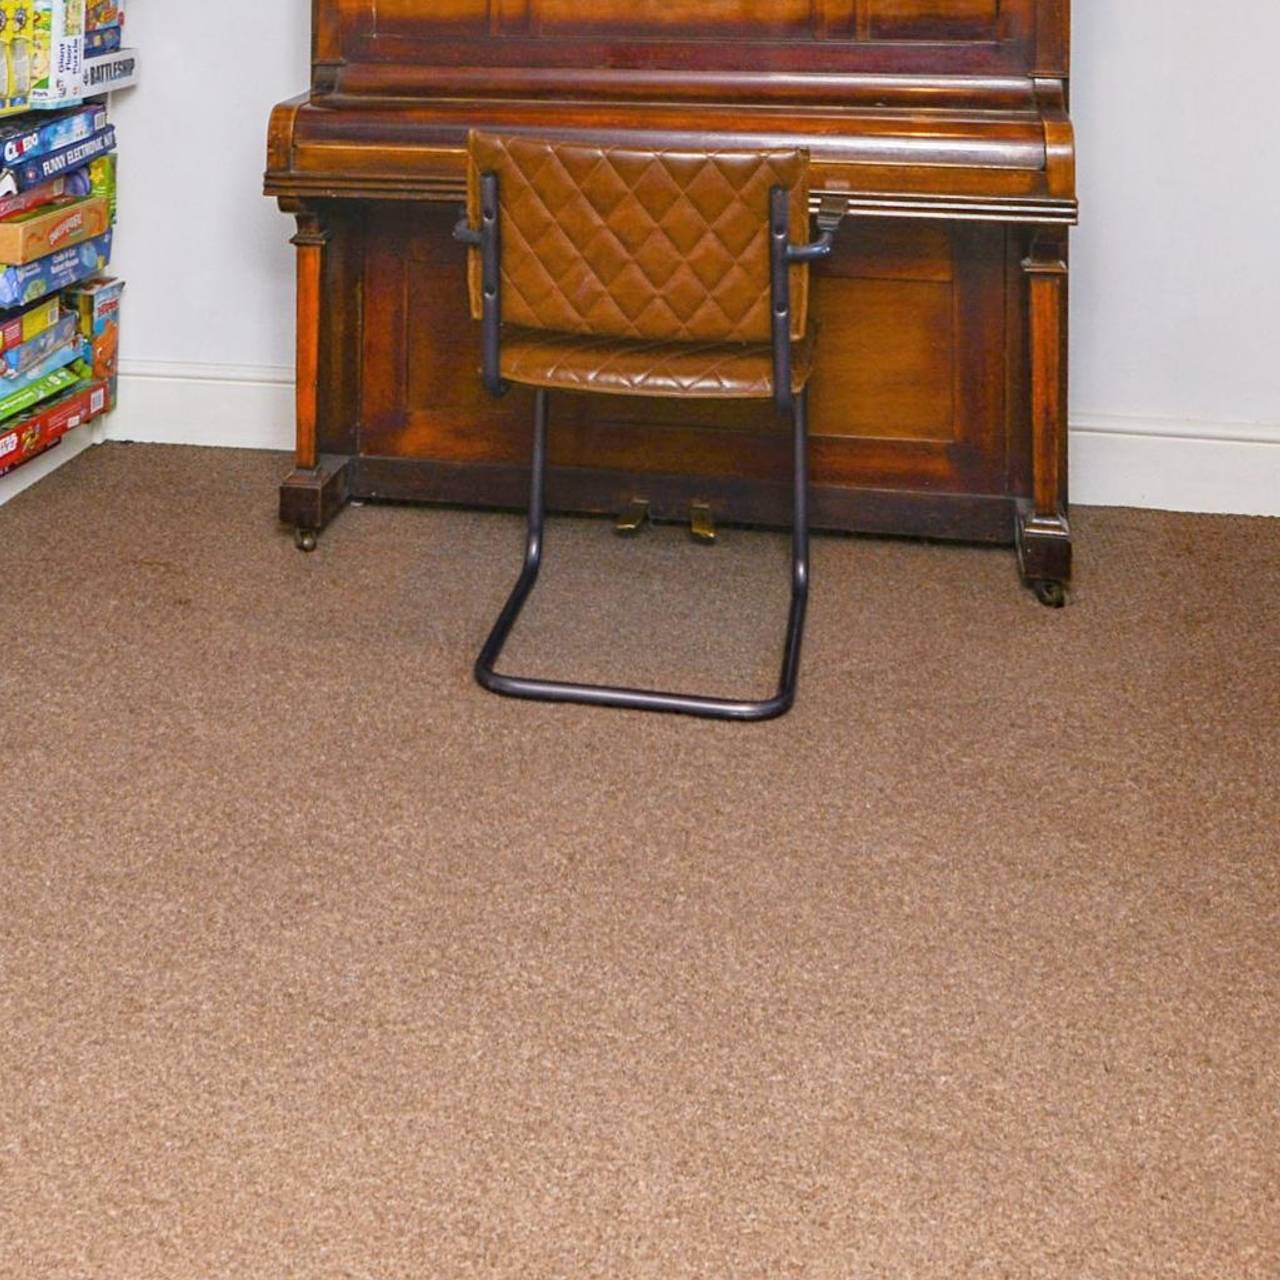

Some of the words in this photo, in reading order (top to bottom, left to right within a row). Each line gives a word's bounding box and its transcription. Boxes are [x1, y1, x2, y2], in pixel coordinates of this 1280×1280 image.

[89, 58, 135, 86] BATTLESHIP
[42, 154, 66, 177] FUNNY
[67, 136, 105, 164] ELECTRONIC
